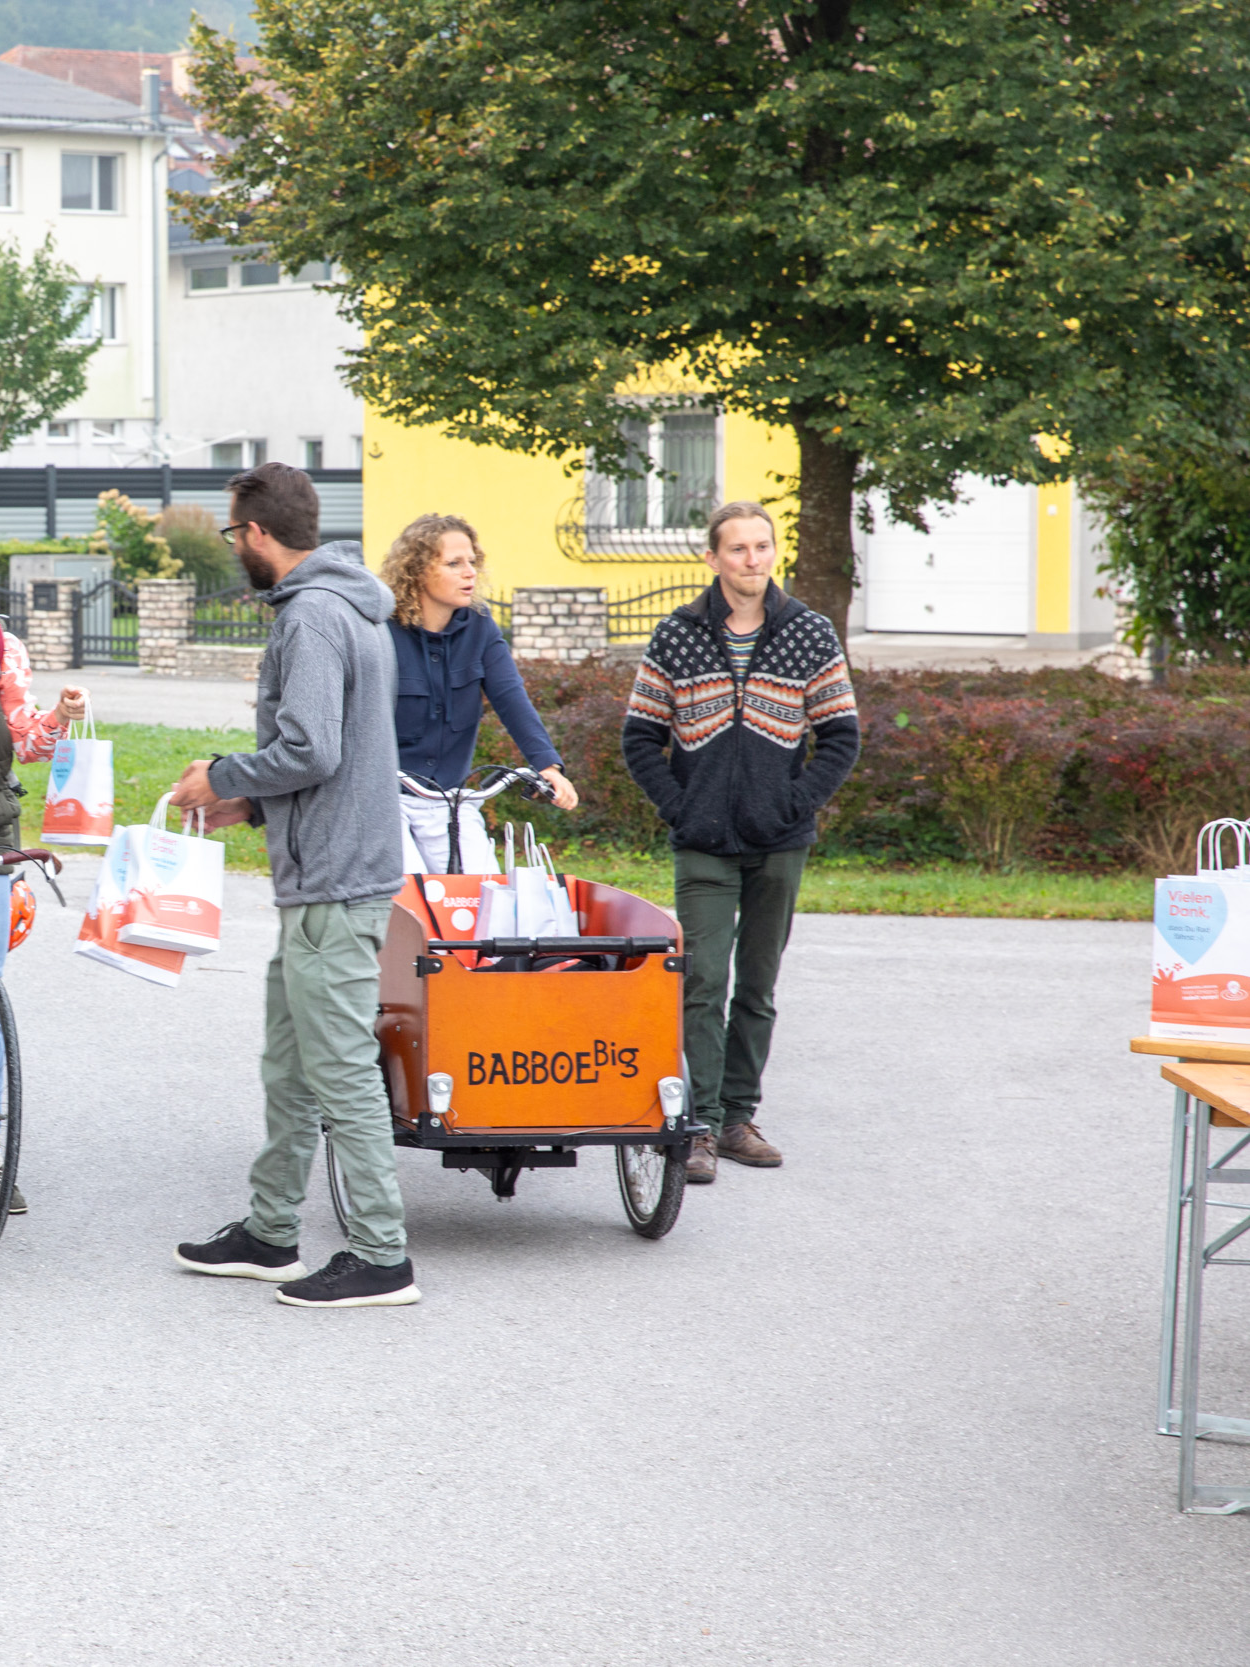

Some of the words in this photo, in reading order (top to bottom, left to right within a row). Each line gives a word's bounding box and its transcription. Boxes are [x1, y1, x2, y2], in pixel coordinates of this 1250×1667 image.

[443, 896, 480, 907] BABBOE
[1167, 890, 1213, 904] Vielen
[468, 1051, 599, 1085] BABBOE
[594, 1039, 640, 1078] Big
